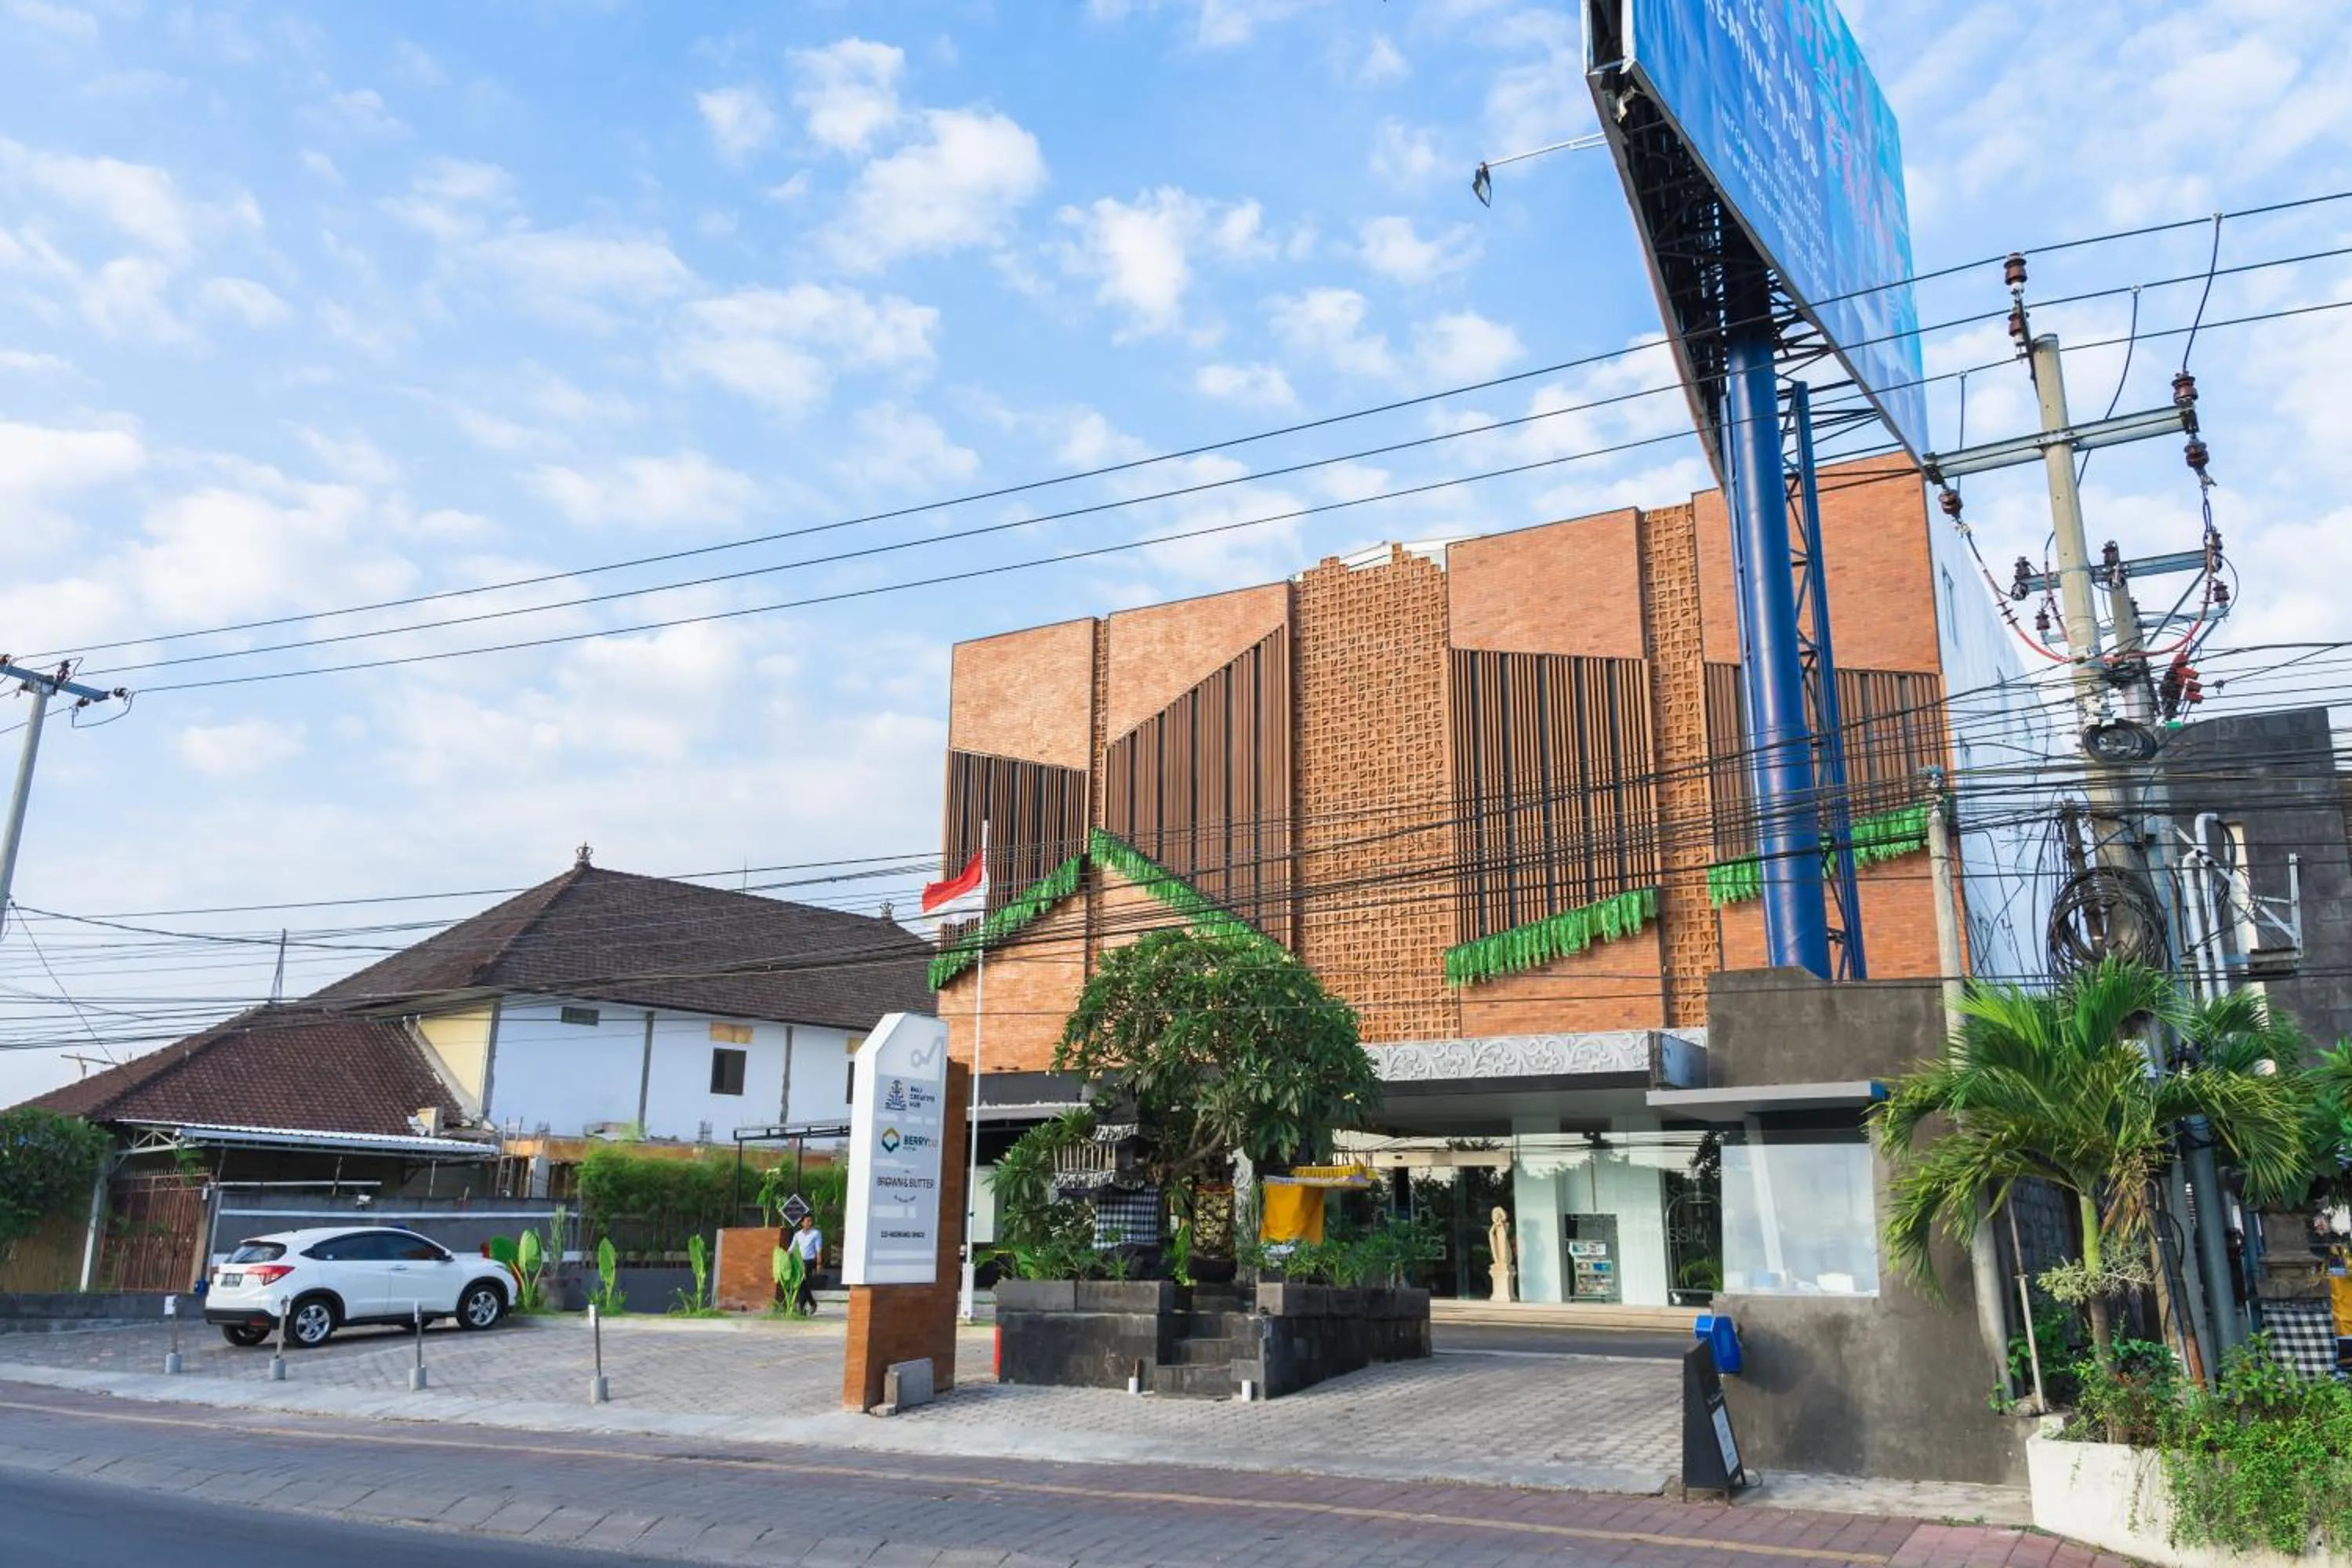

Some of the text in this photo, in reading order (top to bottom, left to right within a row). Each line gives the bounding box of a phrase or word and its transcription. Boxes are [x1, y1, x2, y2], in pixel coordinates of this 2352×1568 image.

[1743, 0, 1812, 120] ESS AND
[1779, 91, 1819, 178] PODS
